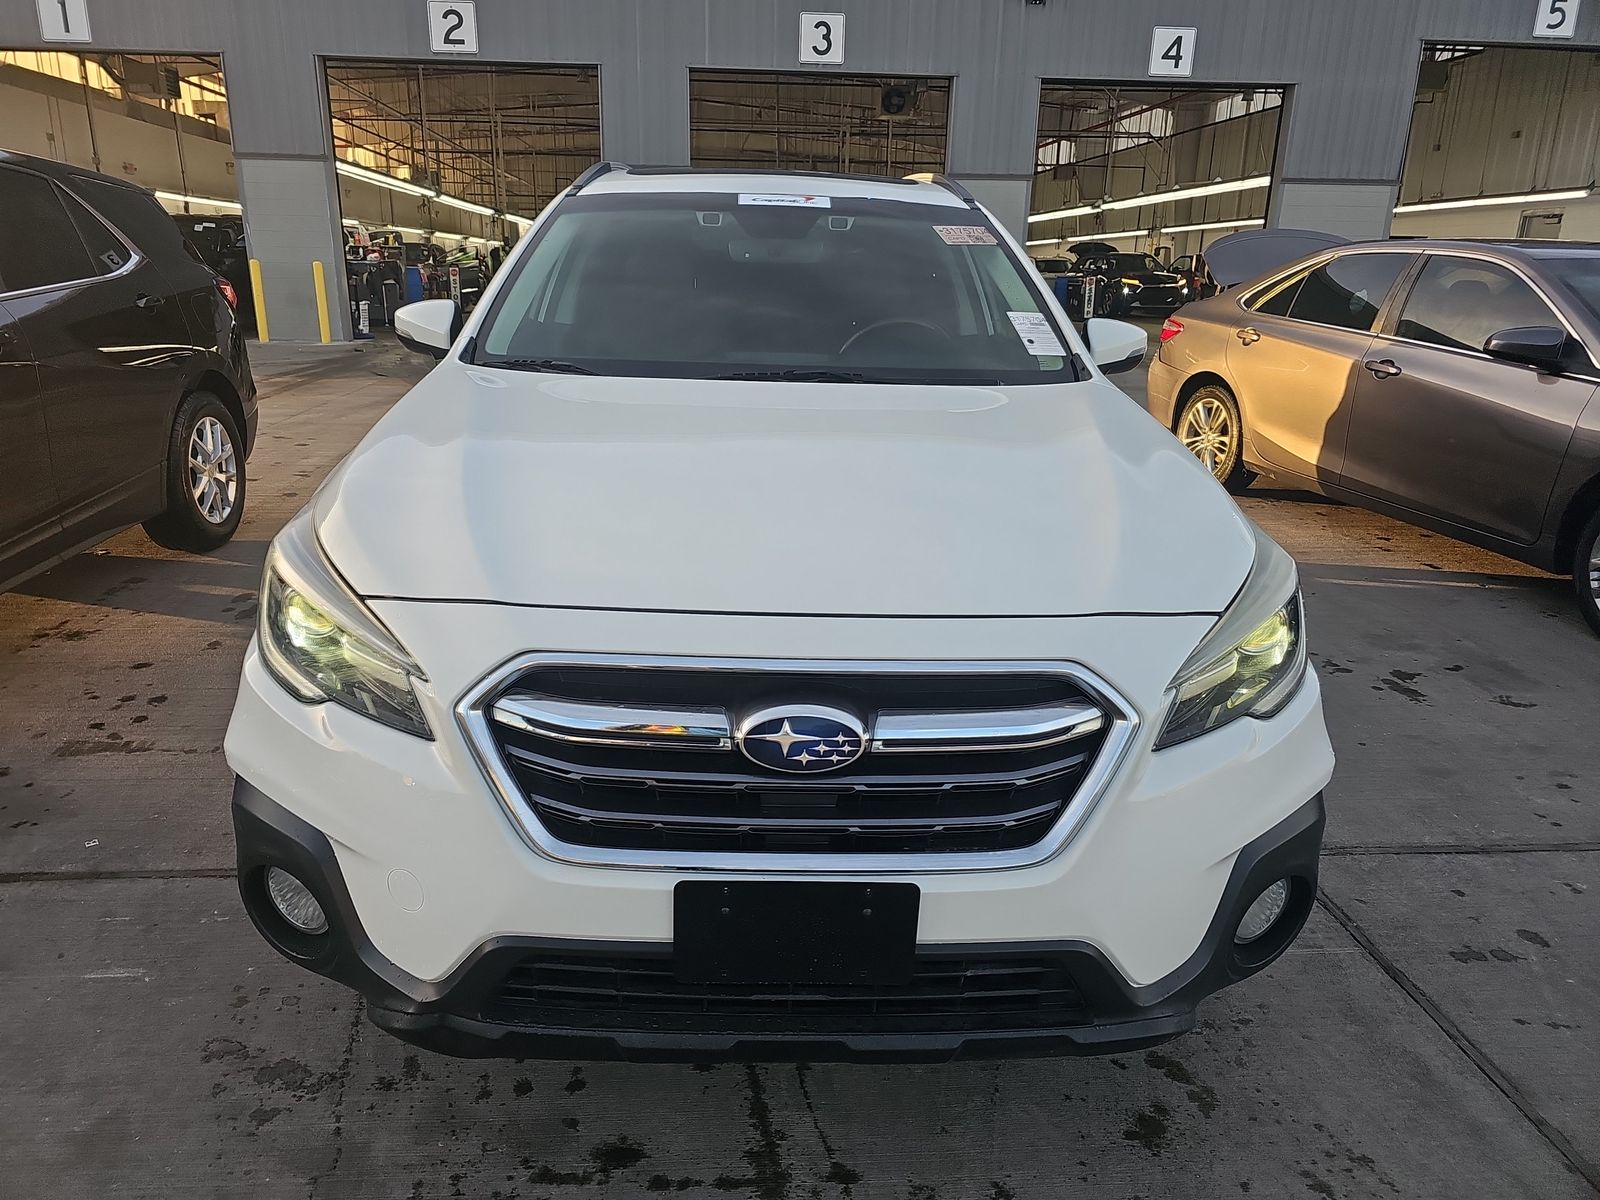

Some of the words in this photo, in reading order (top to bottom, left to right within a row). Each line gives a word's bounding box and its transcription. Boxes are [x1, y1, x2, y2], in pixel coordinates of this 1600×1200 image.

[57, 0, 70, 33] 1
[441, 9, 465, 44] 2
[1546, 0, 1567, 29] 5
[812, 21, 832, 55] 3
[1161, 36, 1182, 68] 4
